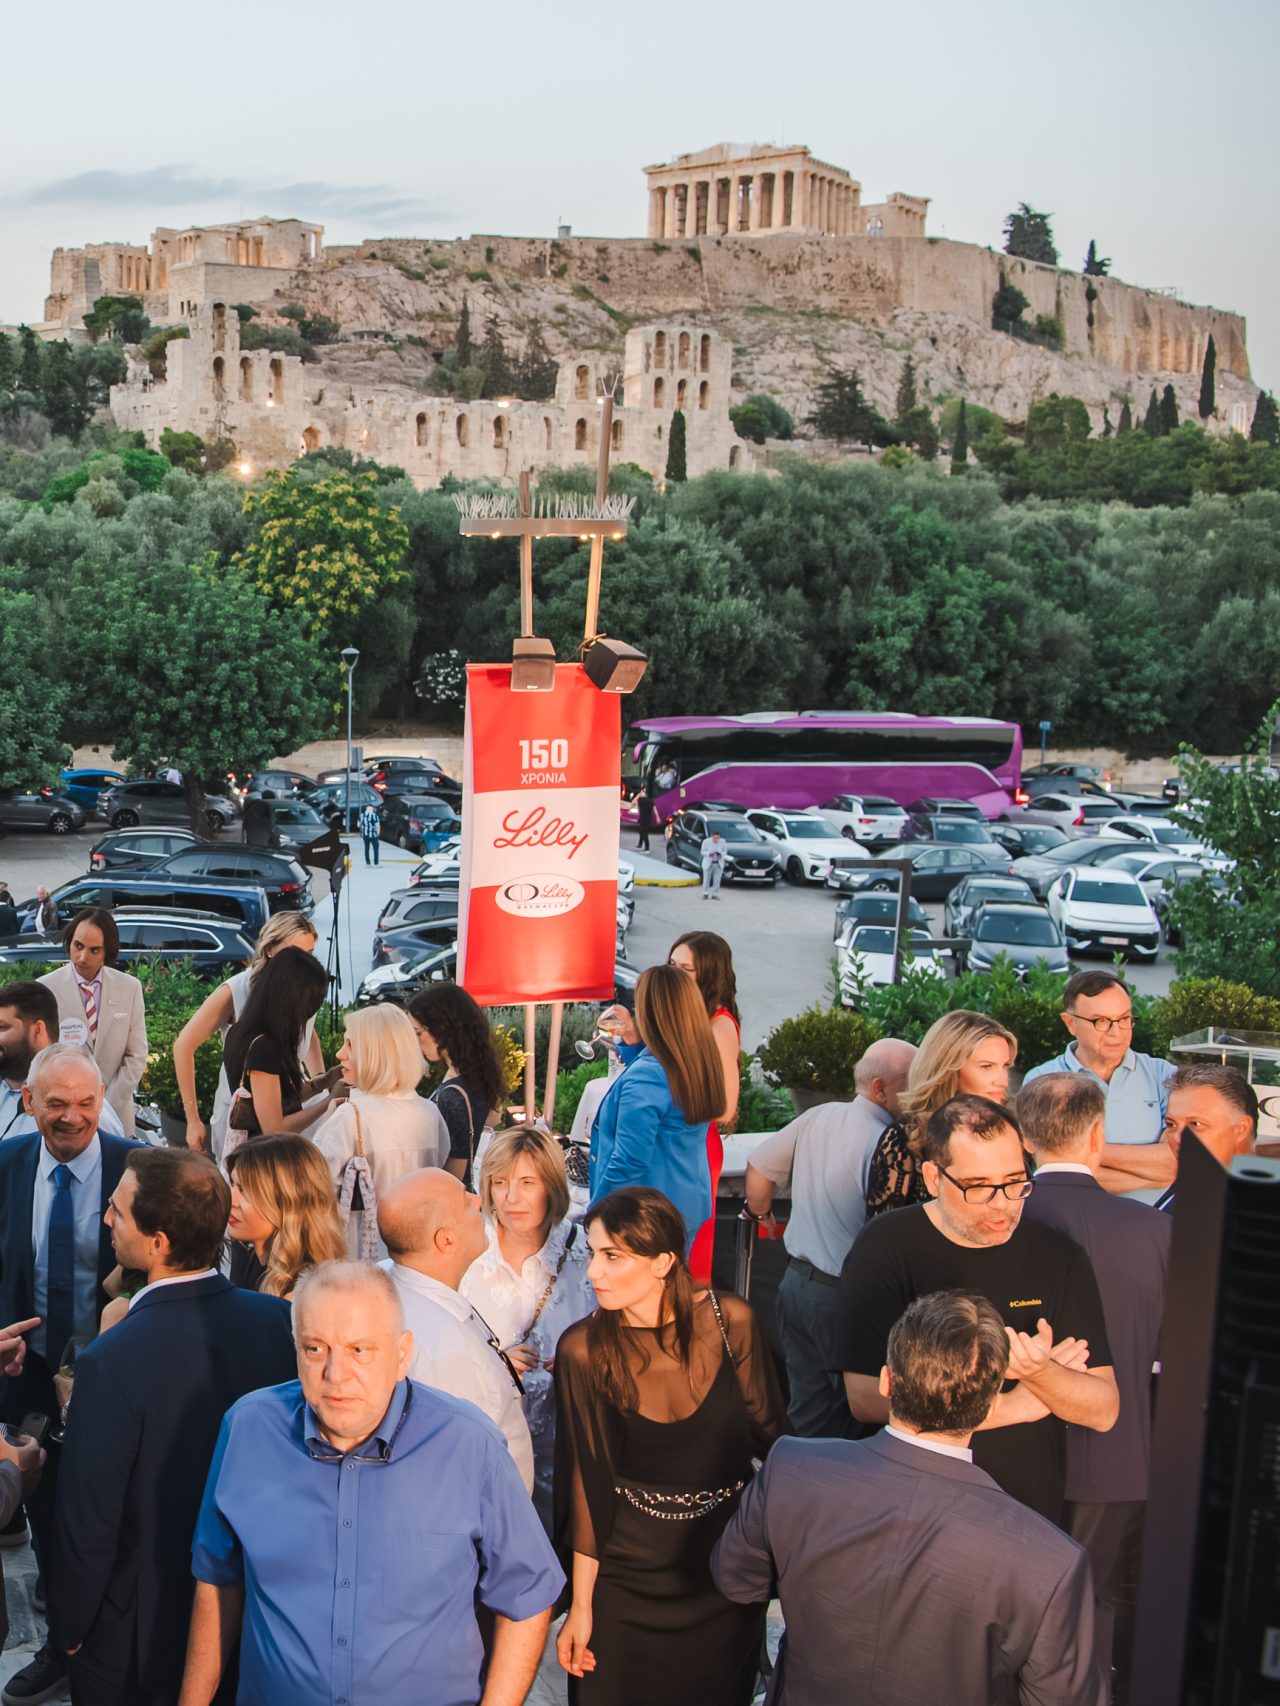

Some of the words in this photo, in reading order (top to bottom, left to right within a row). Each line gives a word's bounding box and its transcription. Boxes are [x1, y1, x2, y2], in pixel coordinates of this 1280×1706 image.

[519, 739, 568, 769] 150
[521, 772, 567, 785] ΧΡΟΝΙΑ
[493, 806, 589, 859] Lilly
[541, 883, 573, 902] Lilly
